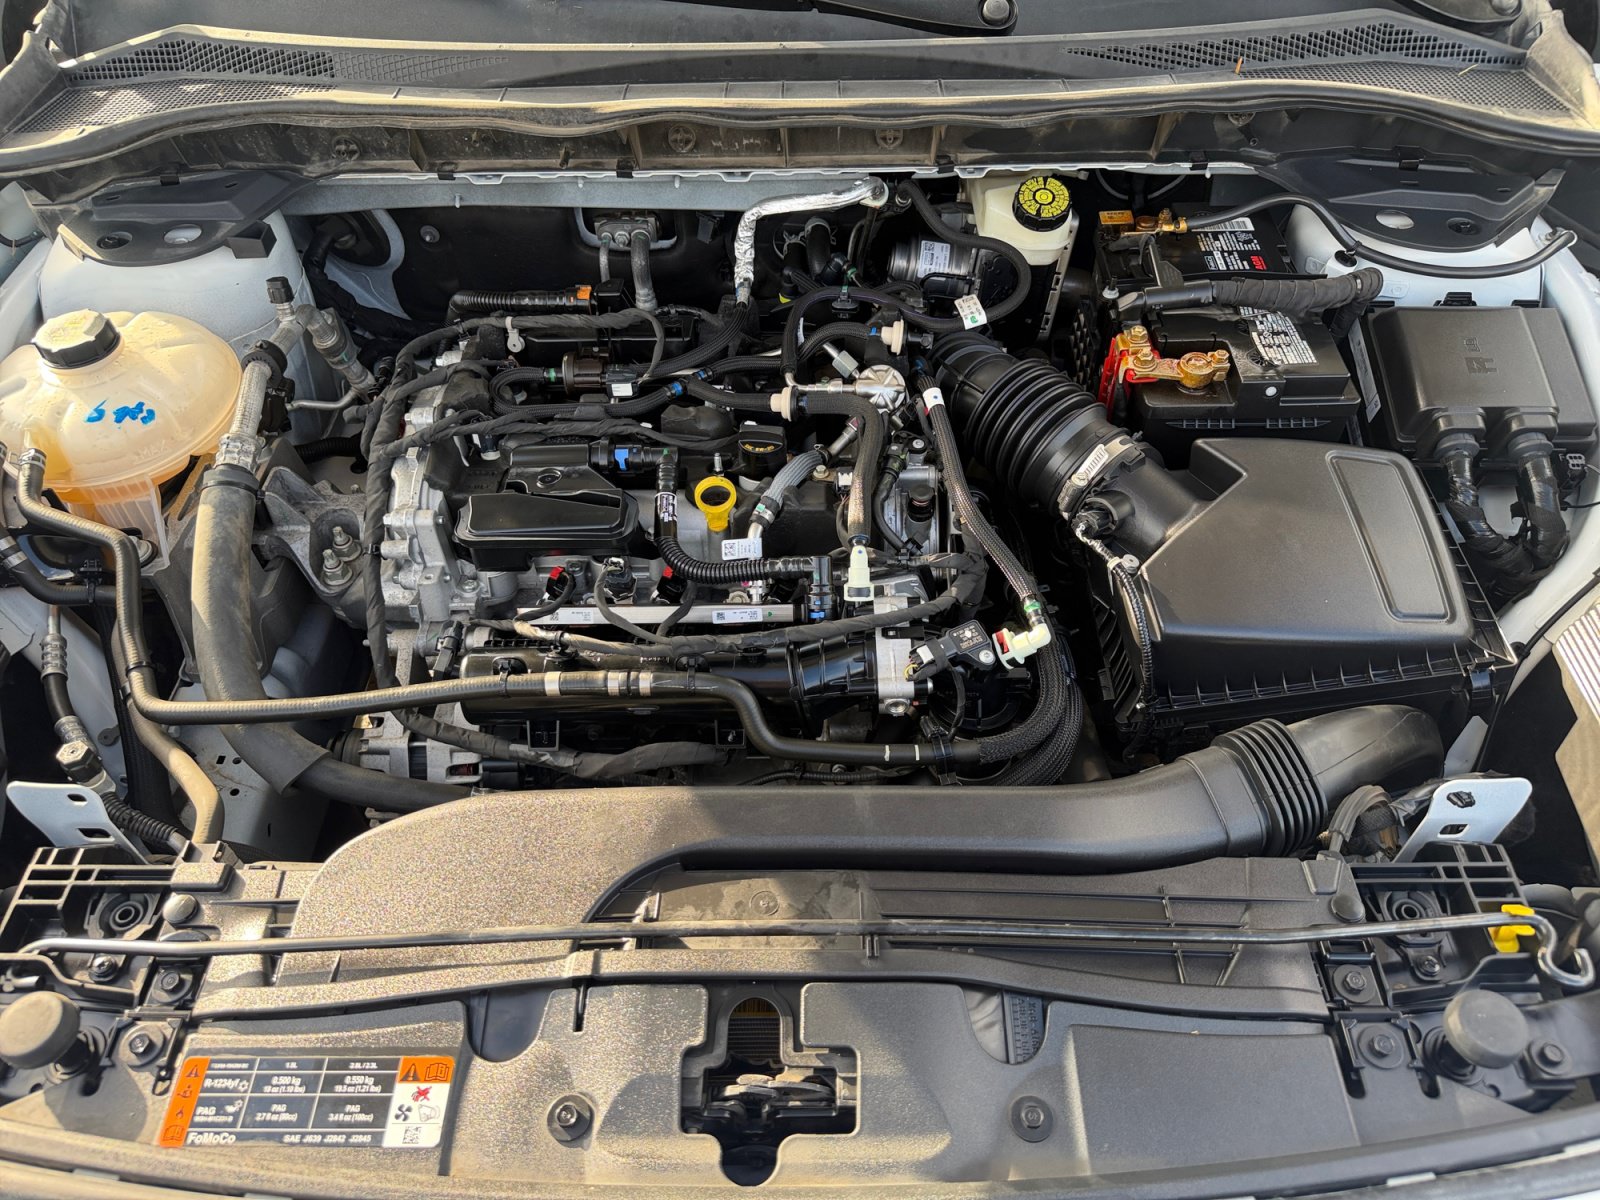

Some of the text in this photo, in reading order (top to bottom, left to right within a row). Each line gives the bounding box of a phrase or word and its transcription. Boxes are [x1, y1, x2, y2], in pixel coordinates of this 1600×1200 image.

[204, 1079, 239, 1090] R-1234yf
[291, 1076, 301, 1086] kg
[364, 1076, 374, 1085] kg
[196, 1107, 216, 1115] PAG
[187, 1132, 237, 1145] FoMoCo
[283, 1135, 301, 1143] SAE
